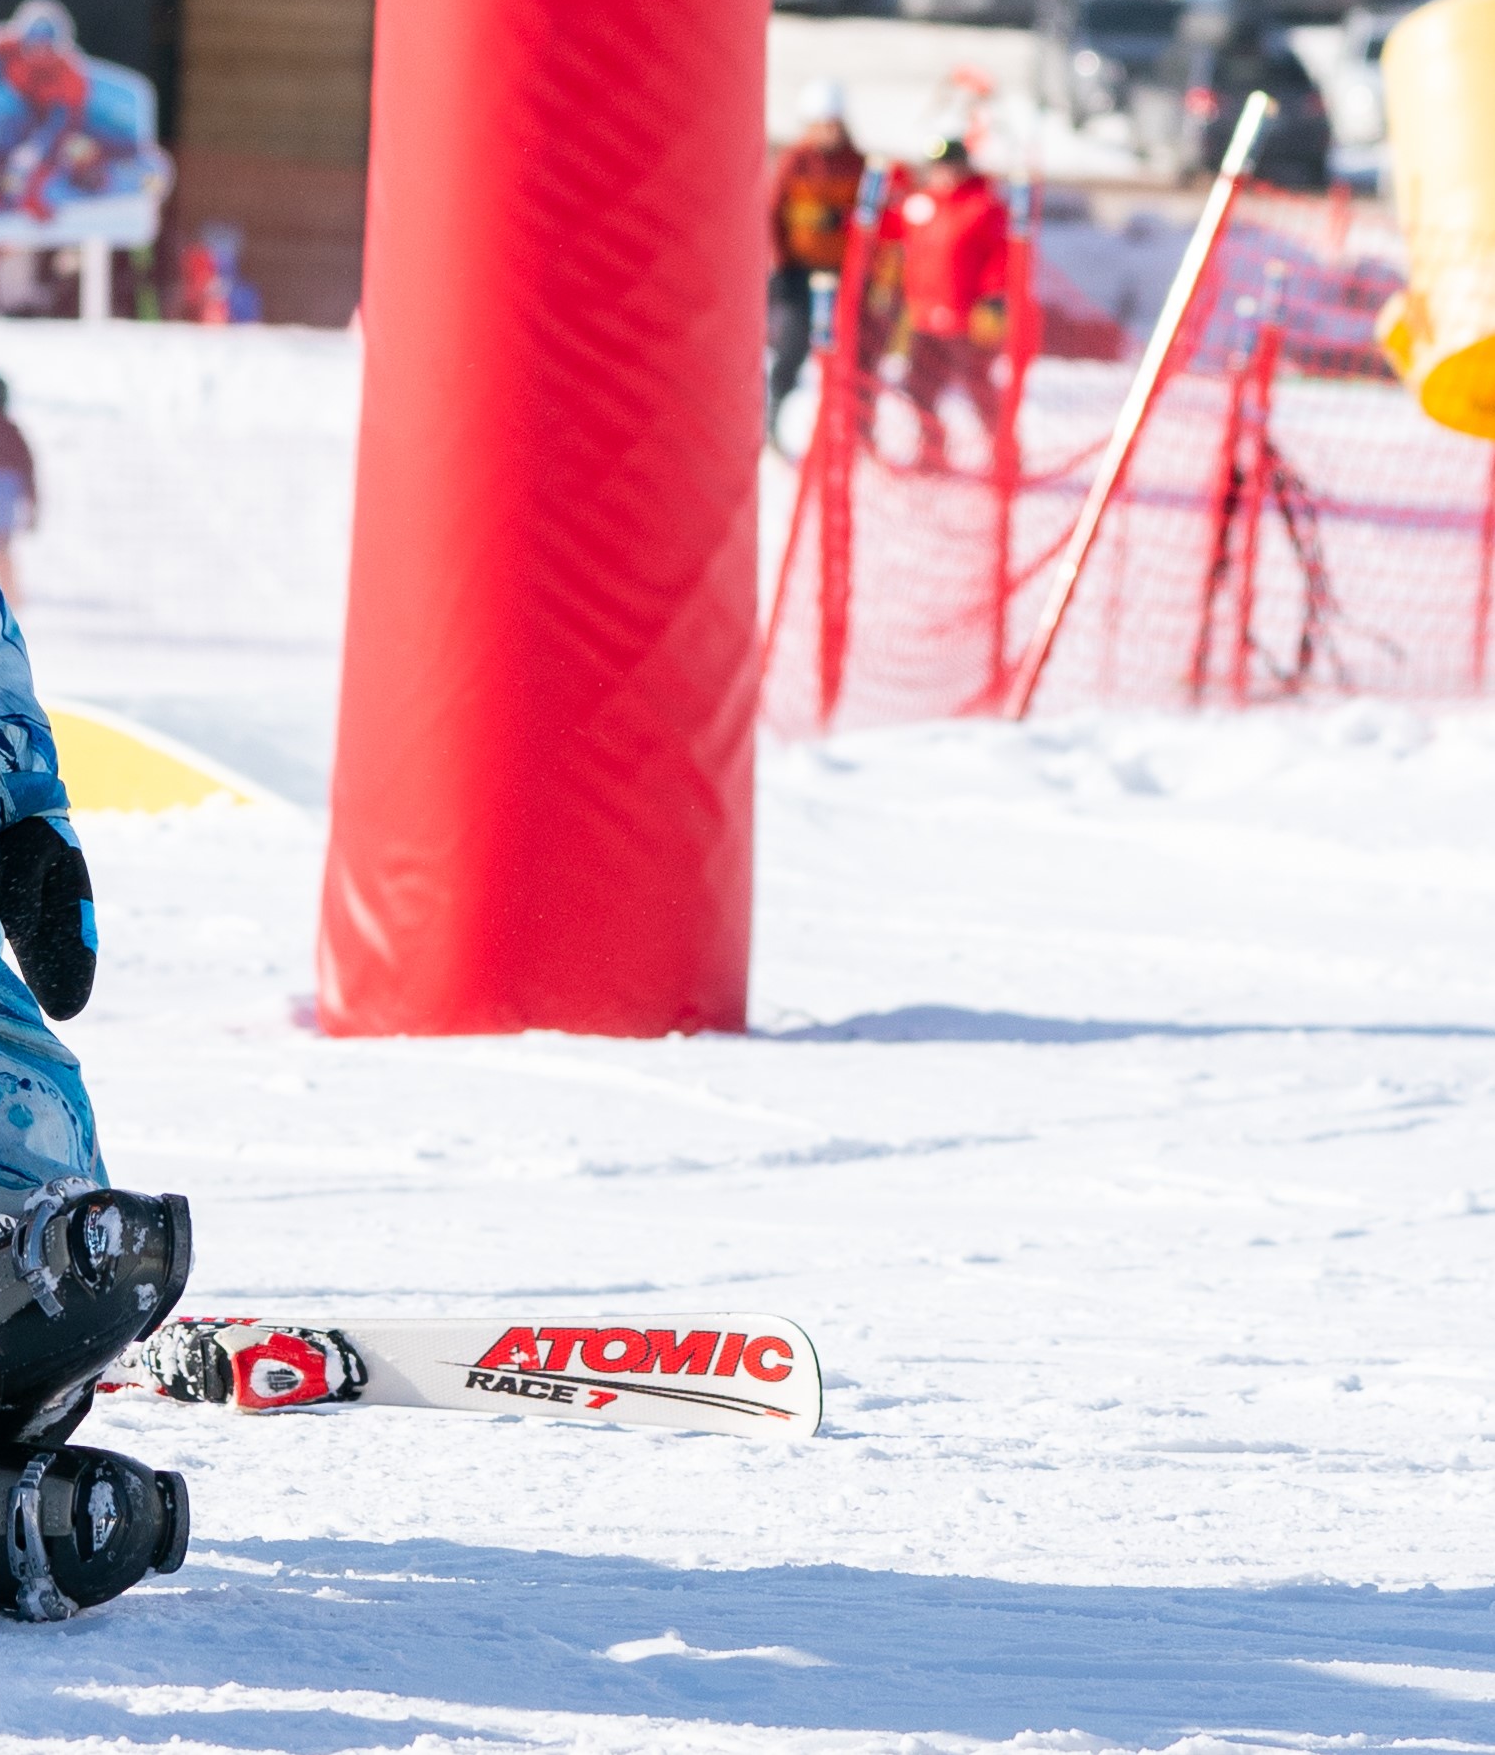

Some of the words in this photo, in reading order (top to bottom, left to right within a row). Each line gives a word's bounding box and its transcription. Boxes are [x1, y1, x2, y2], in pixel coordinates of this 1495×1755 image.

[474, 1327, 794, 1382] ATOMIC
[465, 1370, 579, 1404] RACE
[584, 1389, 618, 1409] 7
